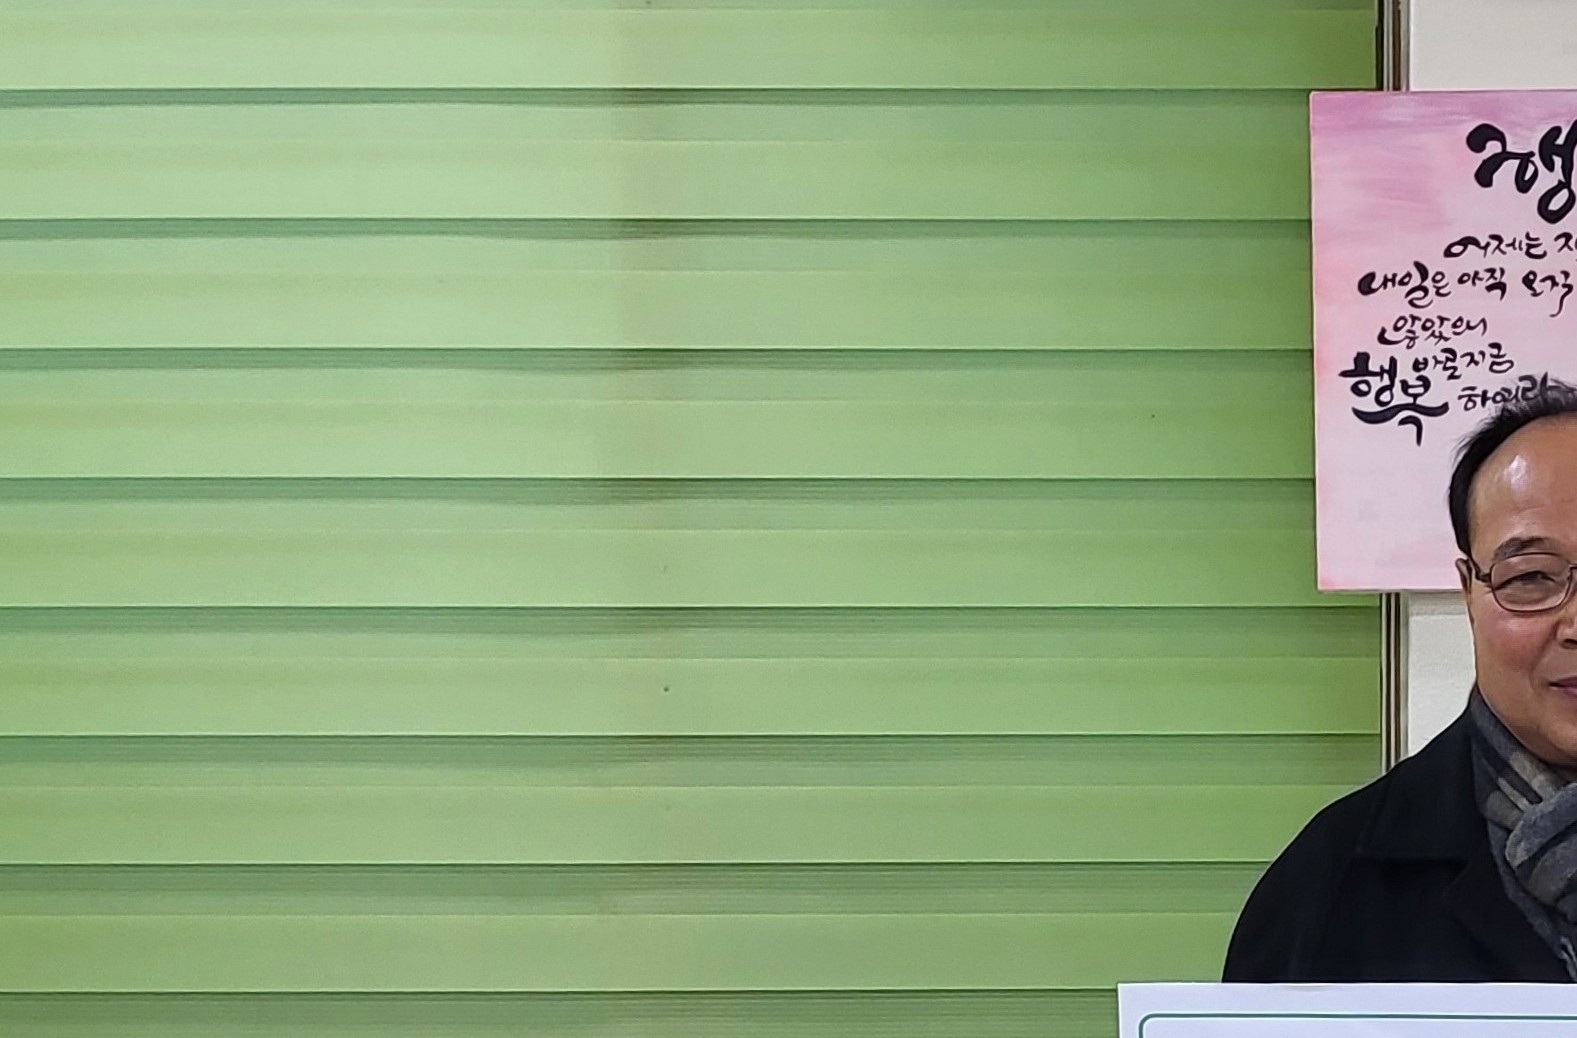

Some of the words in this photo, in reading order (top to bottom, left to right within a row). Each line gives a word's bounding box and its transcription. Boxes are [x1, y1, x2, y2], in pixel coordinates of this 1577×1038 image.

[1443, 231, 1548, 260] 어제는
[1357, 260, 1452, 308] 내일은
[1457, 267, 1507, 300] 아직
[1338, 351, 1449, 446] 행복
